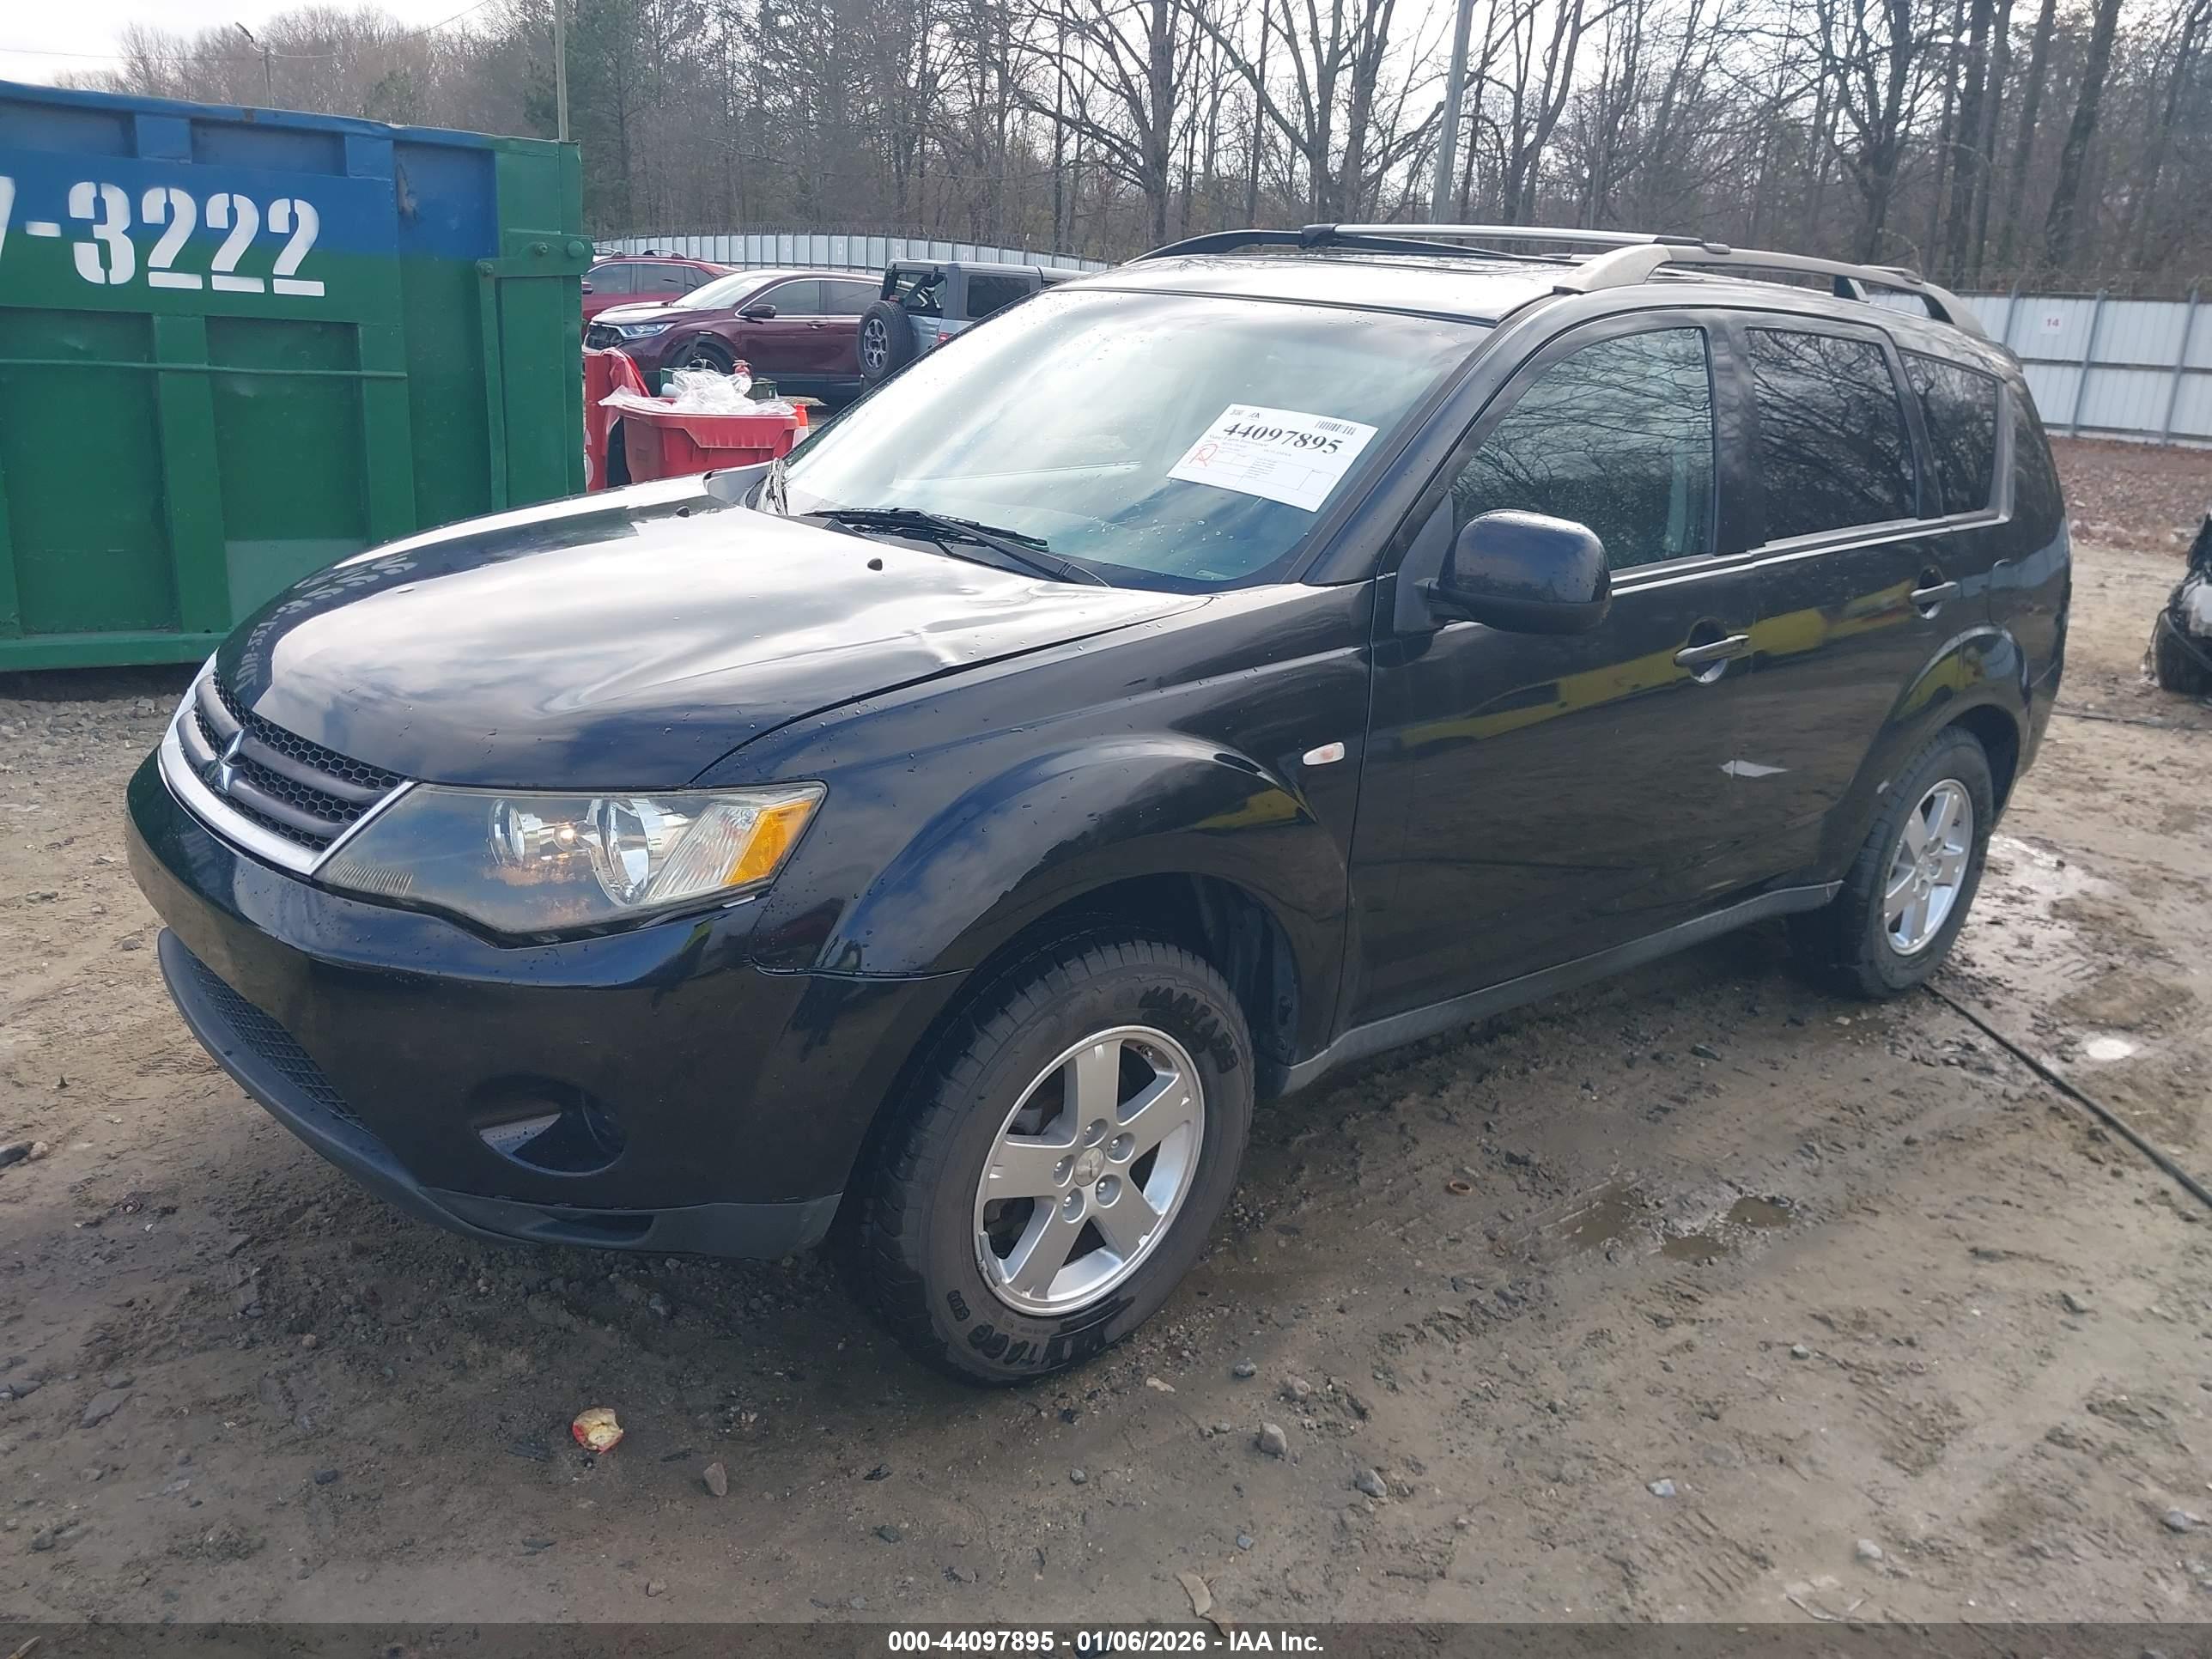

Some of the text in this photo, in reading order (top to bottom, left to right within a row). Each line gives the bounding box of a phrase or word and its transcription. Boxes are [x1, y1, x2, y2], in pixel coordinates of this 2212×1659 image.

[0, 177, 325, 297] -3222
[2046, 317, 2060, 327] 14
[1223, 422, 1344, 455] 44097895
